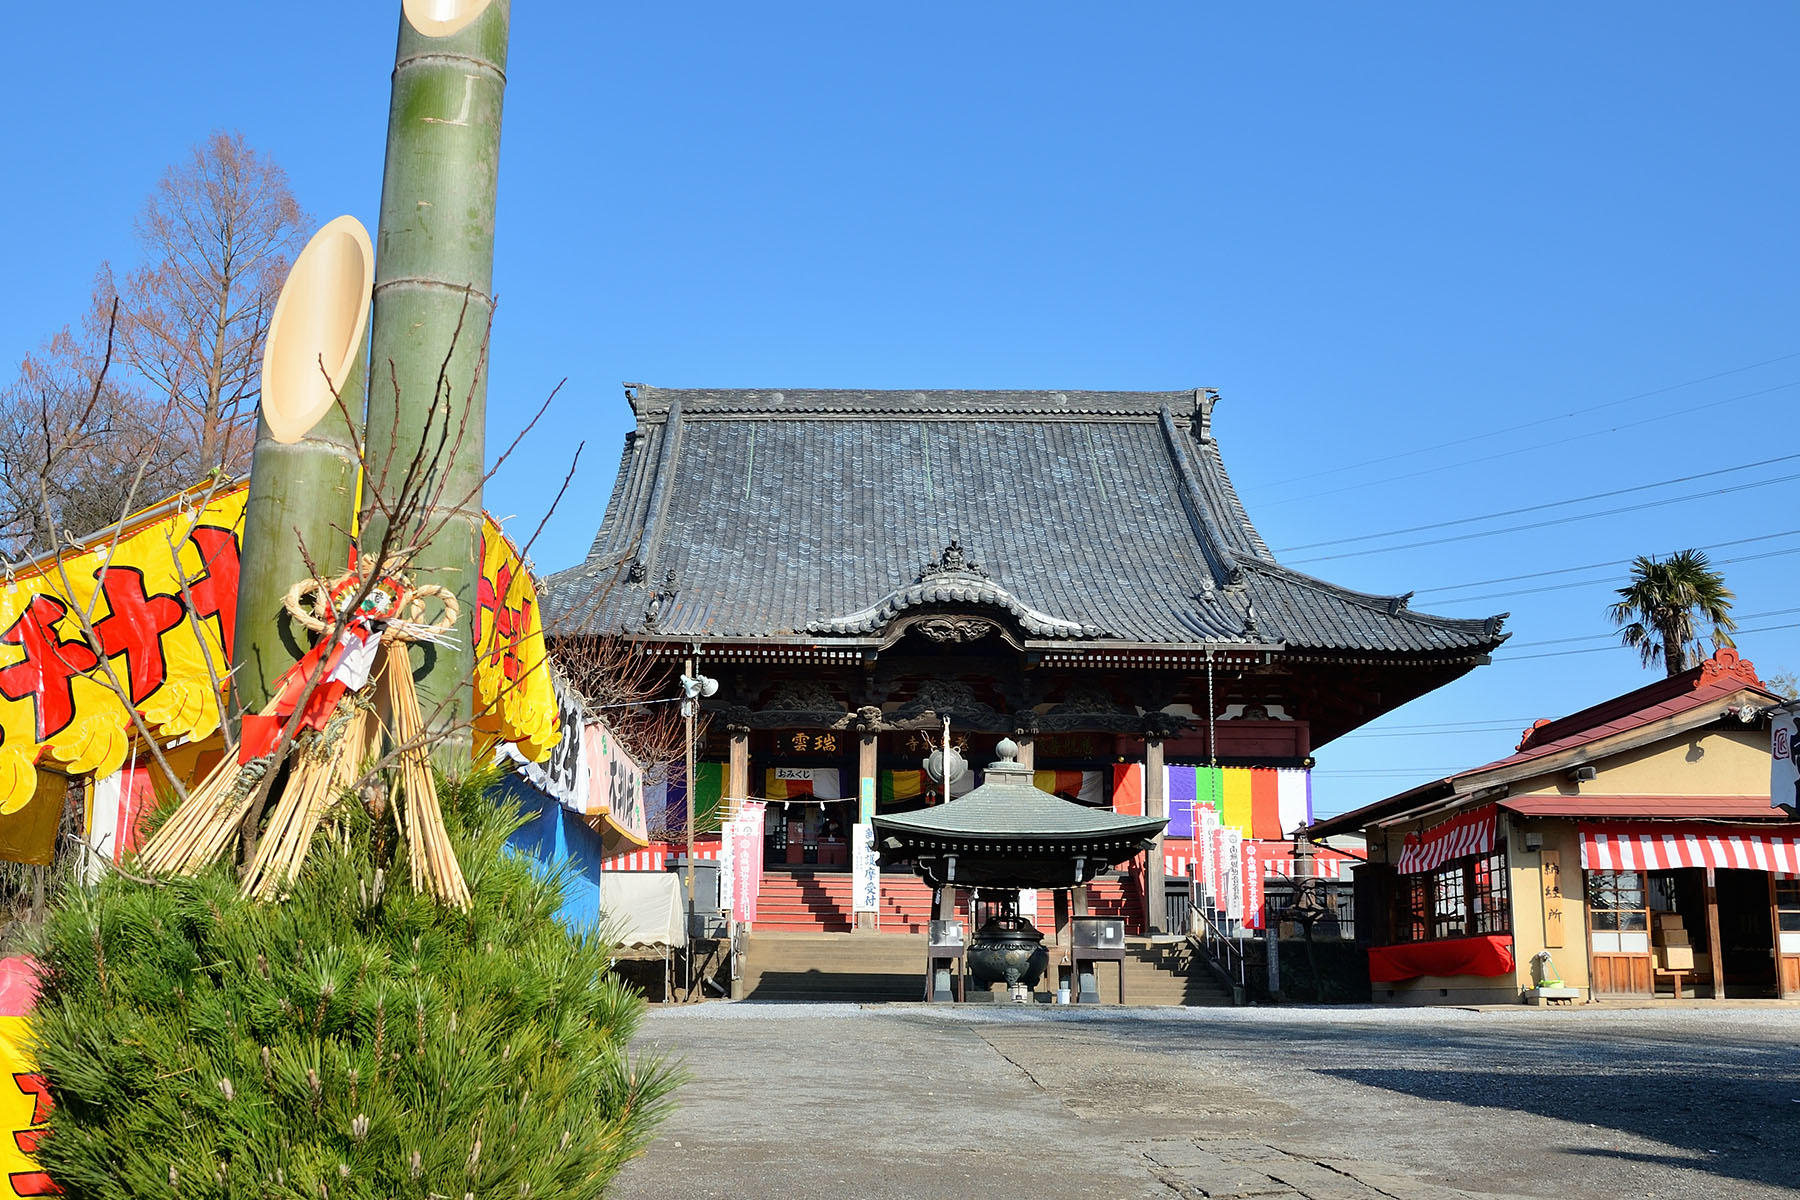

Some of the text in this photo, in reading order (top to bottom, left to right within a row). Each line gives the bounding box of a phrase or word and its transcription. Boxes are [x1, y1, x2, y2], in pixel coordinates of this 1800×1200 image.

[778, 769, 810, 779] おみくじ
[1544, 862, 1562, 923] 納経所
